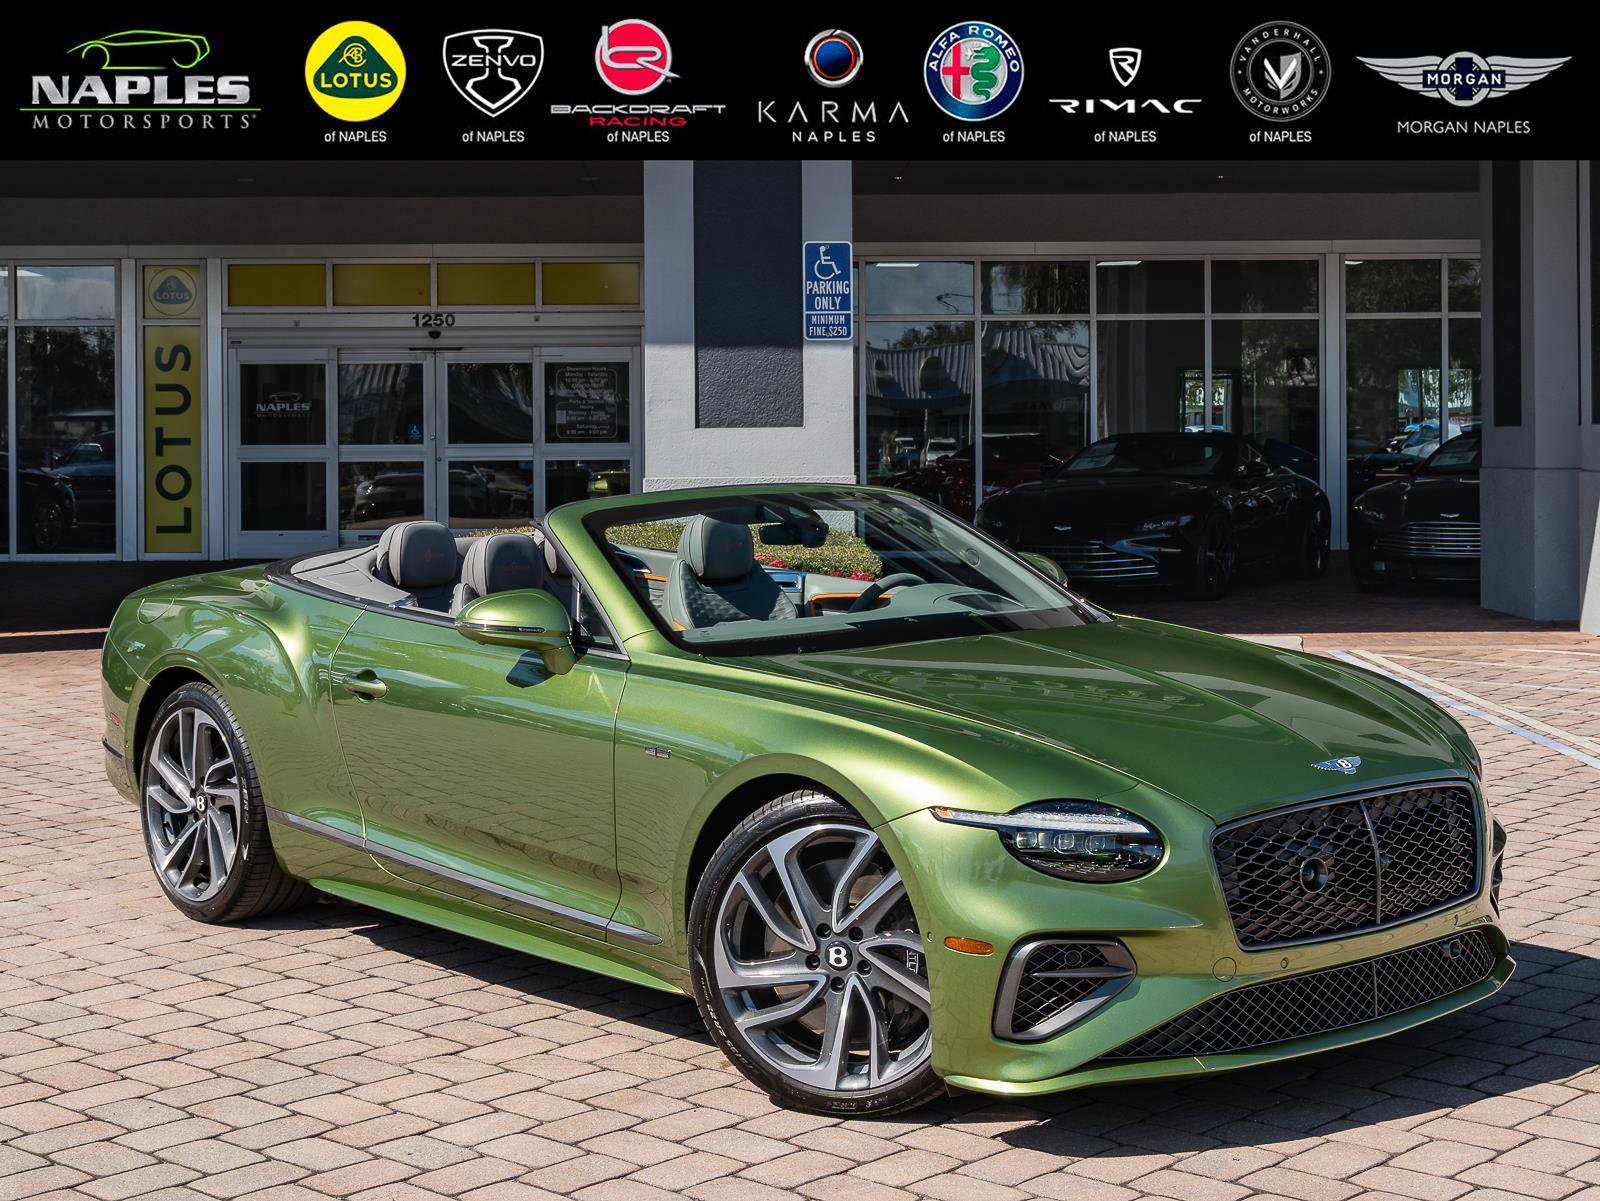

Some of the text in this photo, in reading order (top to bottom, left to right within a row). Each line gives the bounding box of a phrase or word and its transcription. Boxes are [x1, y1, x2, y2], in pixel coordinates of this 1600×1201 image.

[806, 280, 850, 294] PARKING
[155, 288, 190, 300] LOTUS
[814, 296, 842, 310] ONLY
[412, 313, 456, 328] 1250
[811, 314, 846, 325] MINIMUM
[809, 325, 848, 337] FINE $250
[255, 402, 312, 411] NAPLES
[154, 344, 193, 534] LOTUS
